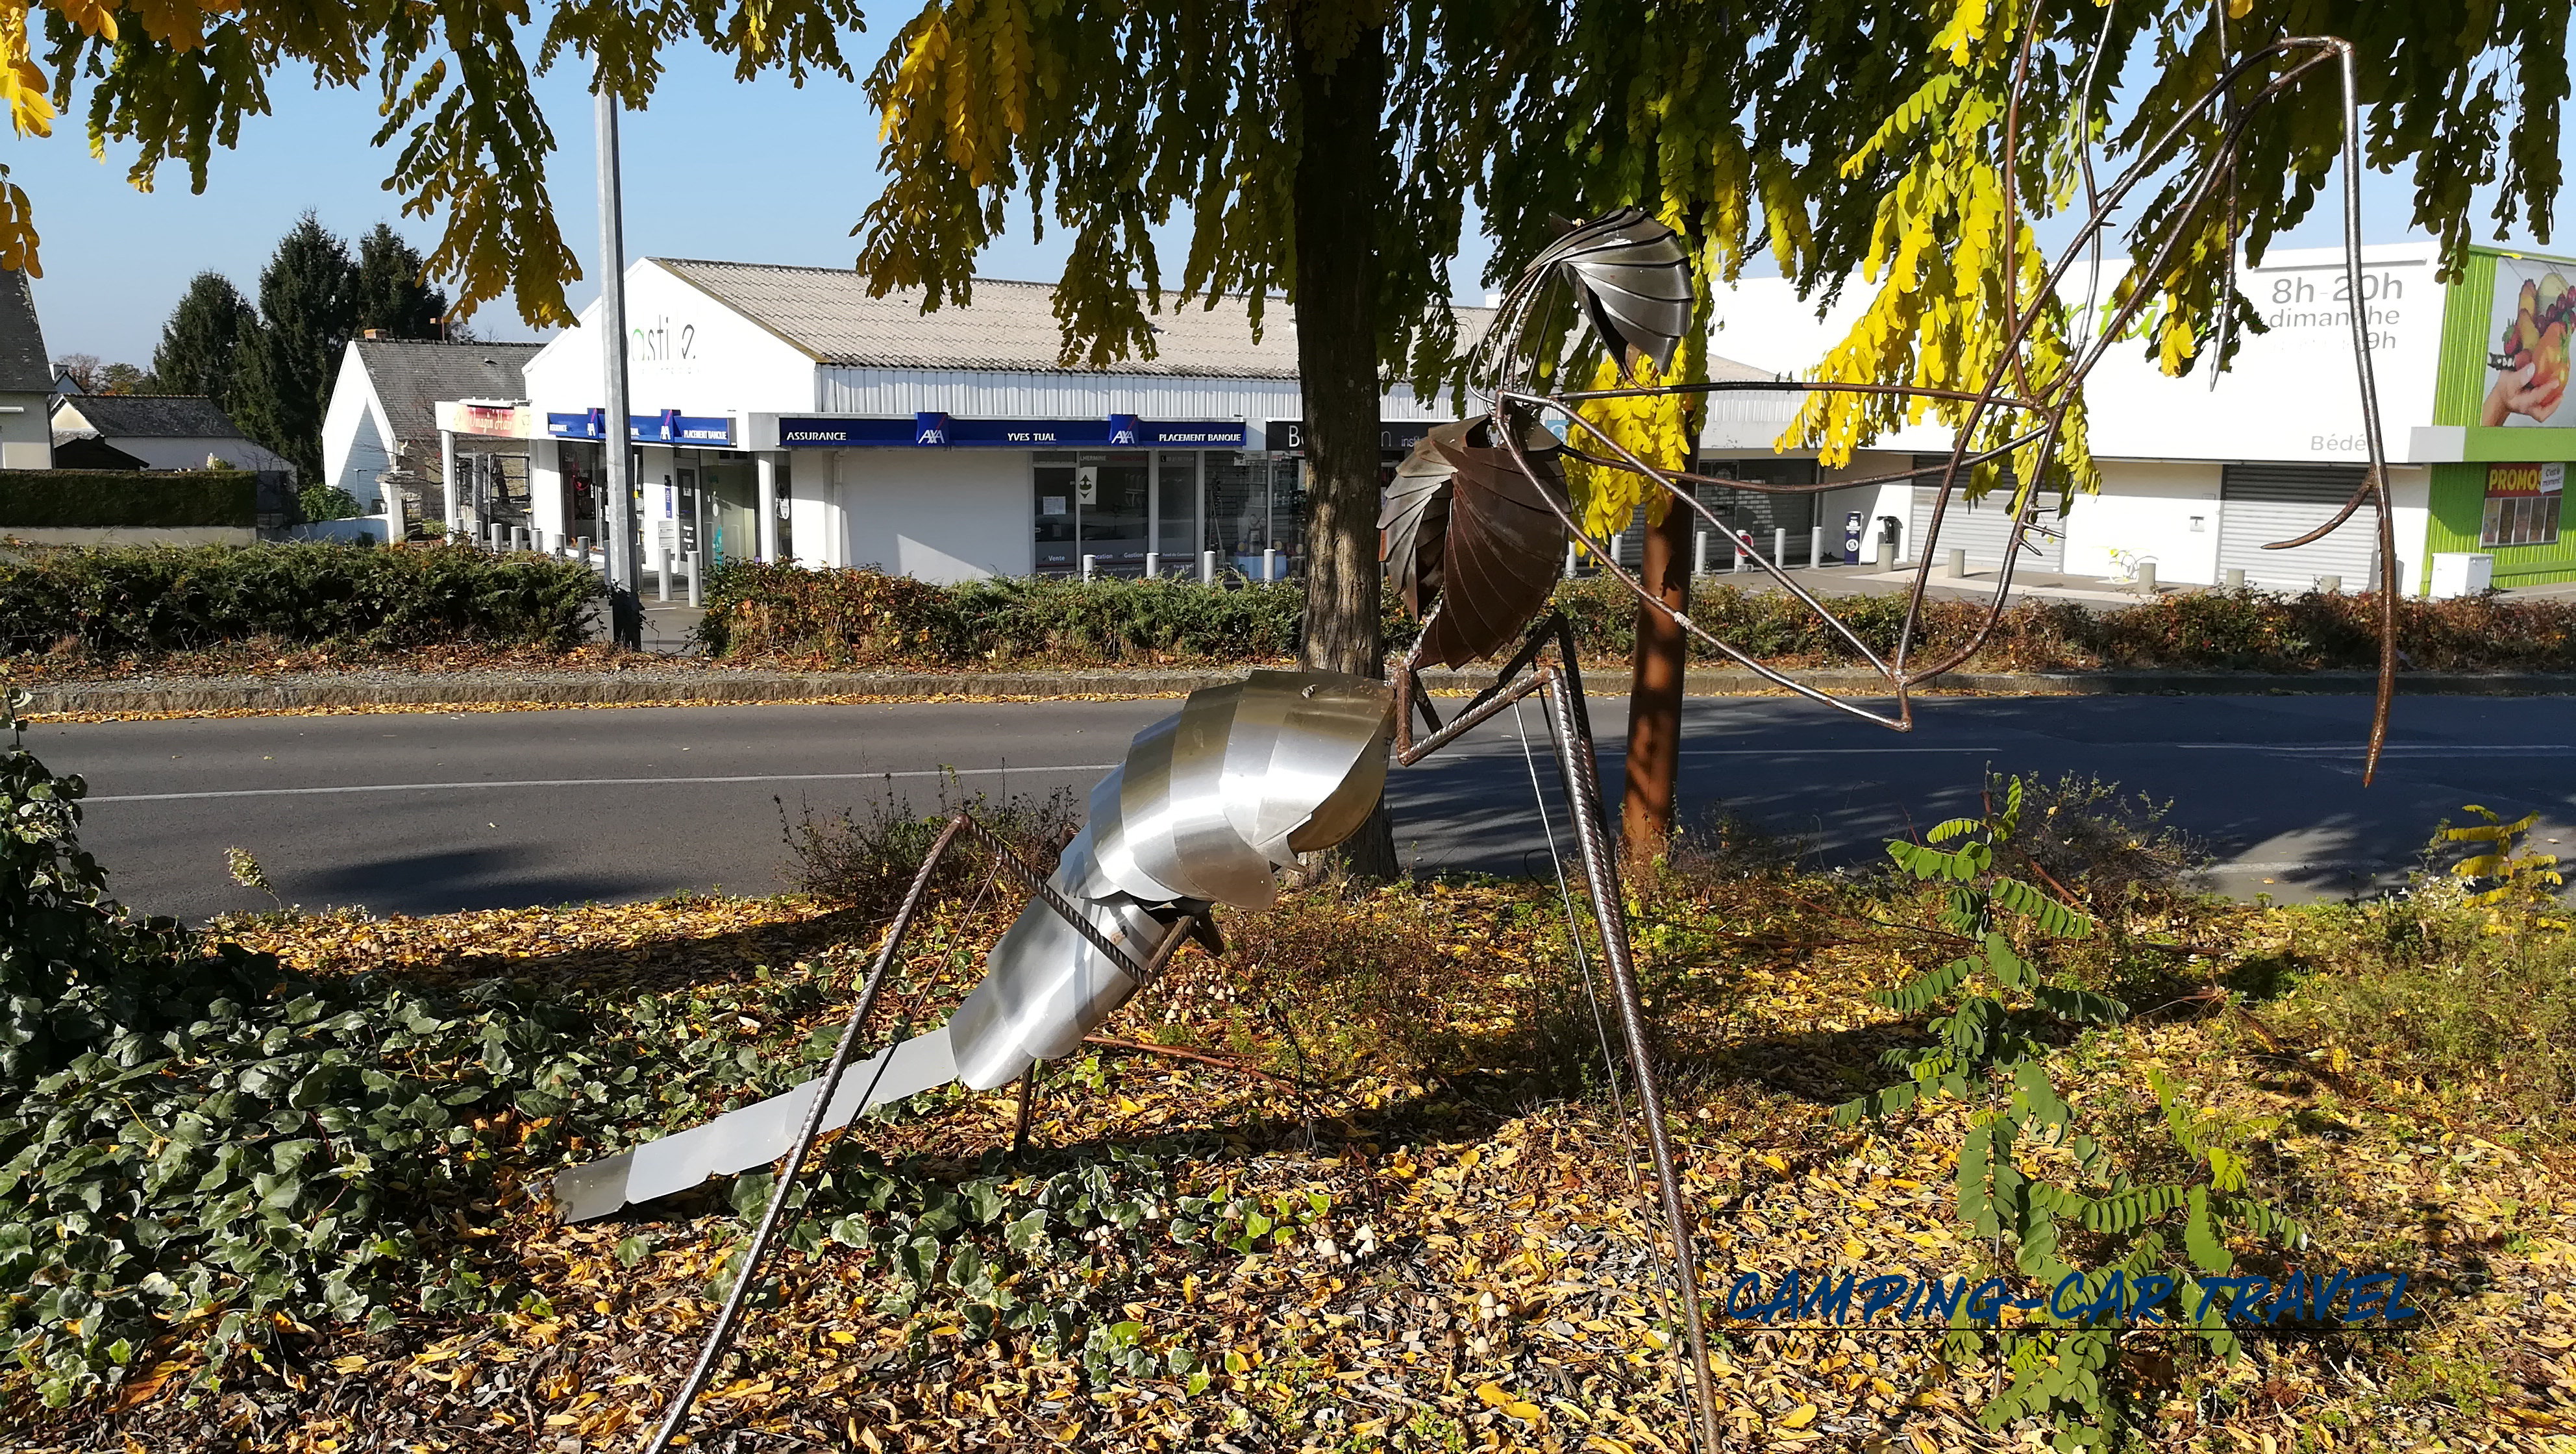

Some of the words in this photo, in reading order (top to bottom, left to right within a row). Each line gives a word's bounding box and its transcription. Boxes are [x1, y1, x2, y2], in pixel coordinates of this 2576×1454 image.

[2269, 305, 2400, 328] dimanhe
[495, 410, 512, 430] Hair
[786, 432, 847, 441] ASSURANCE
[918, 429, 945, 443] AXA
[1008, 433, 1030, 442] YVES
[1033, 433, 1056, 442] TUAL
[1111, 430, 1135, 444] AXA
[1159, 434, 1206, 442] PLACEMENT
[1208, 434, 1241, 442] BANQUE
[2310, 434, 2368, 451] Bédé
